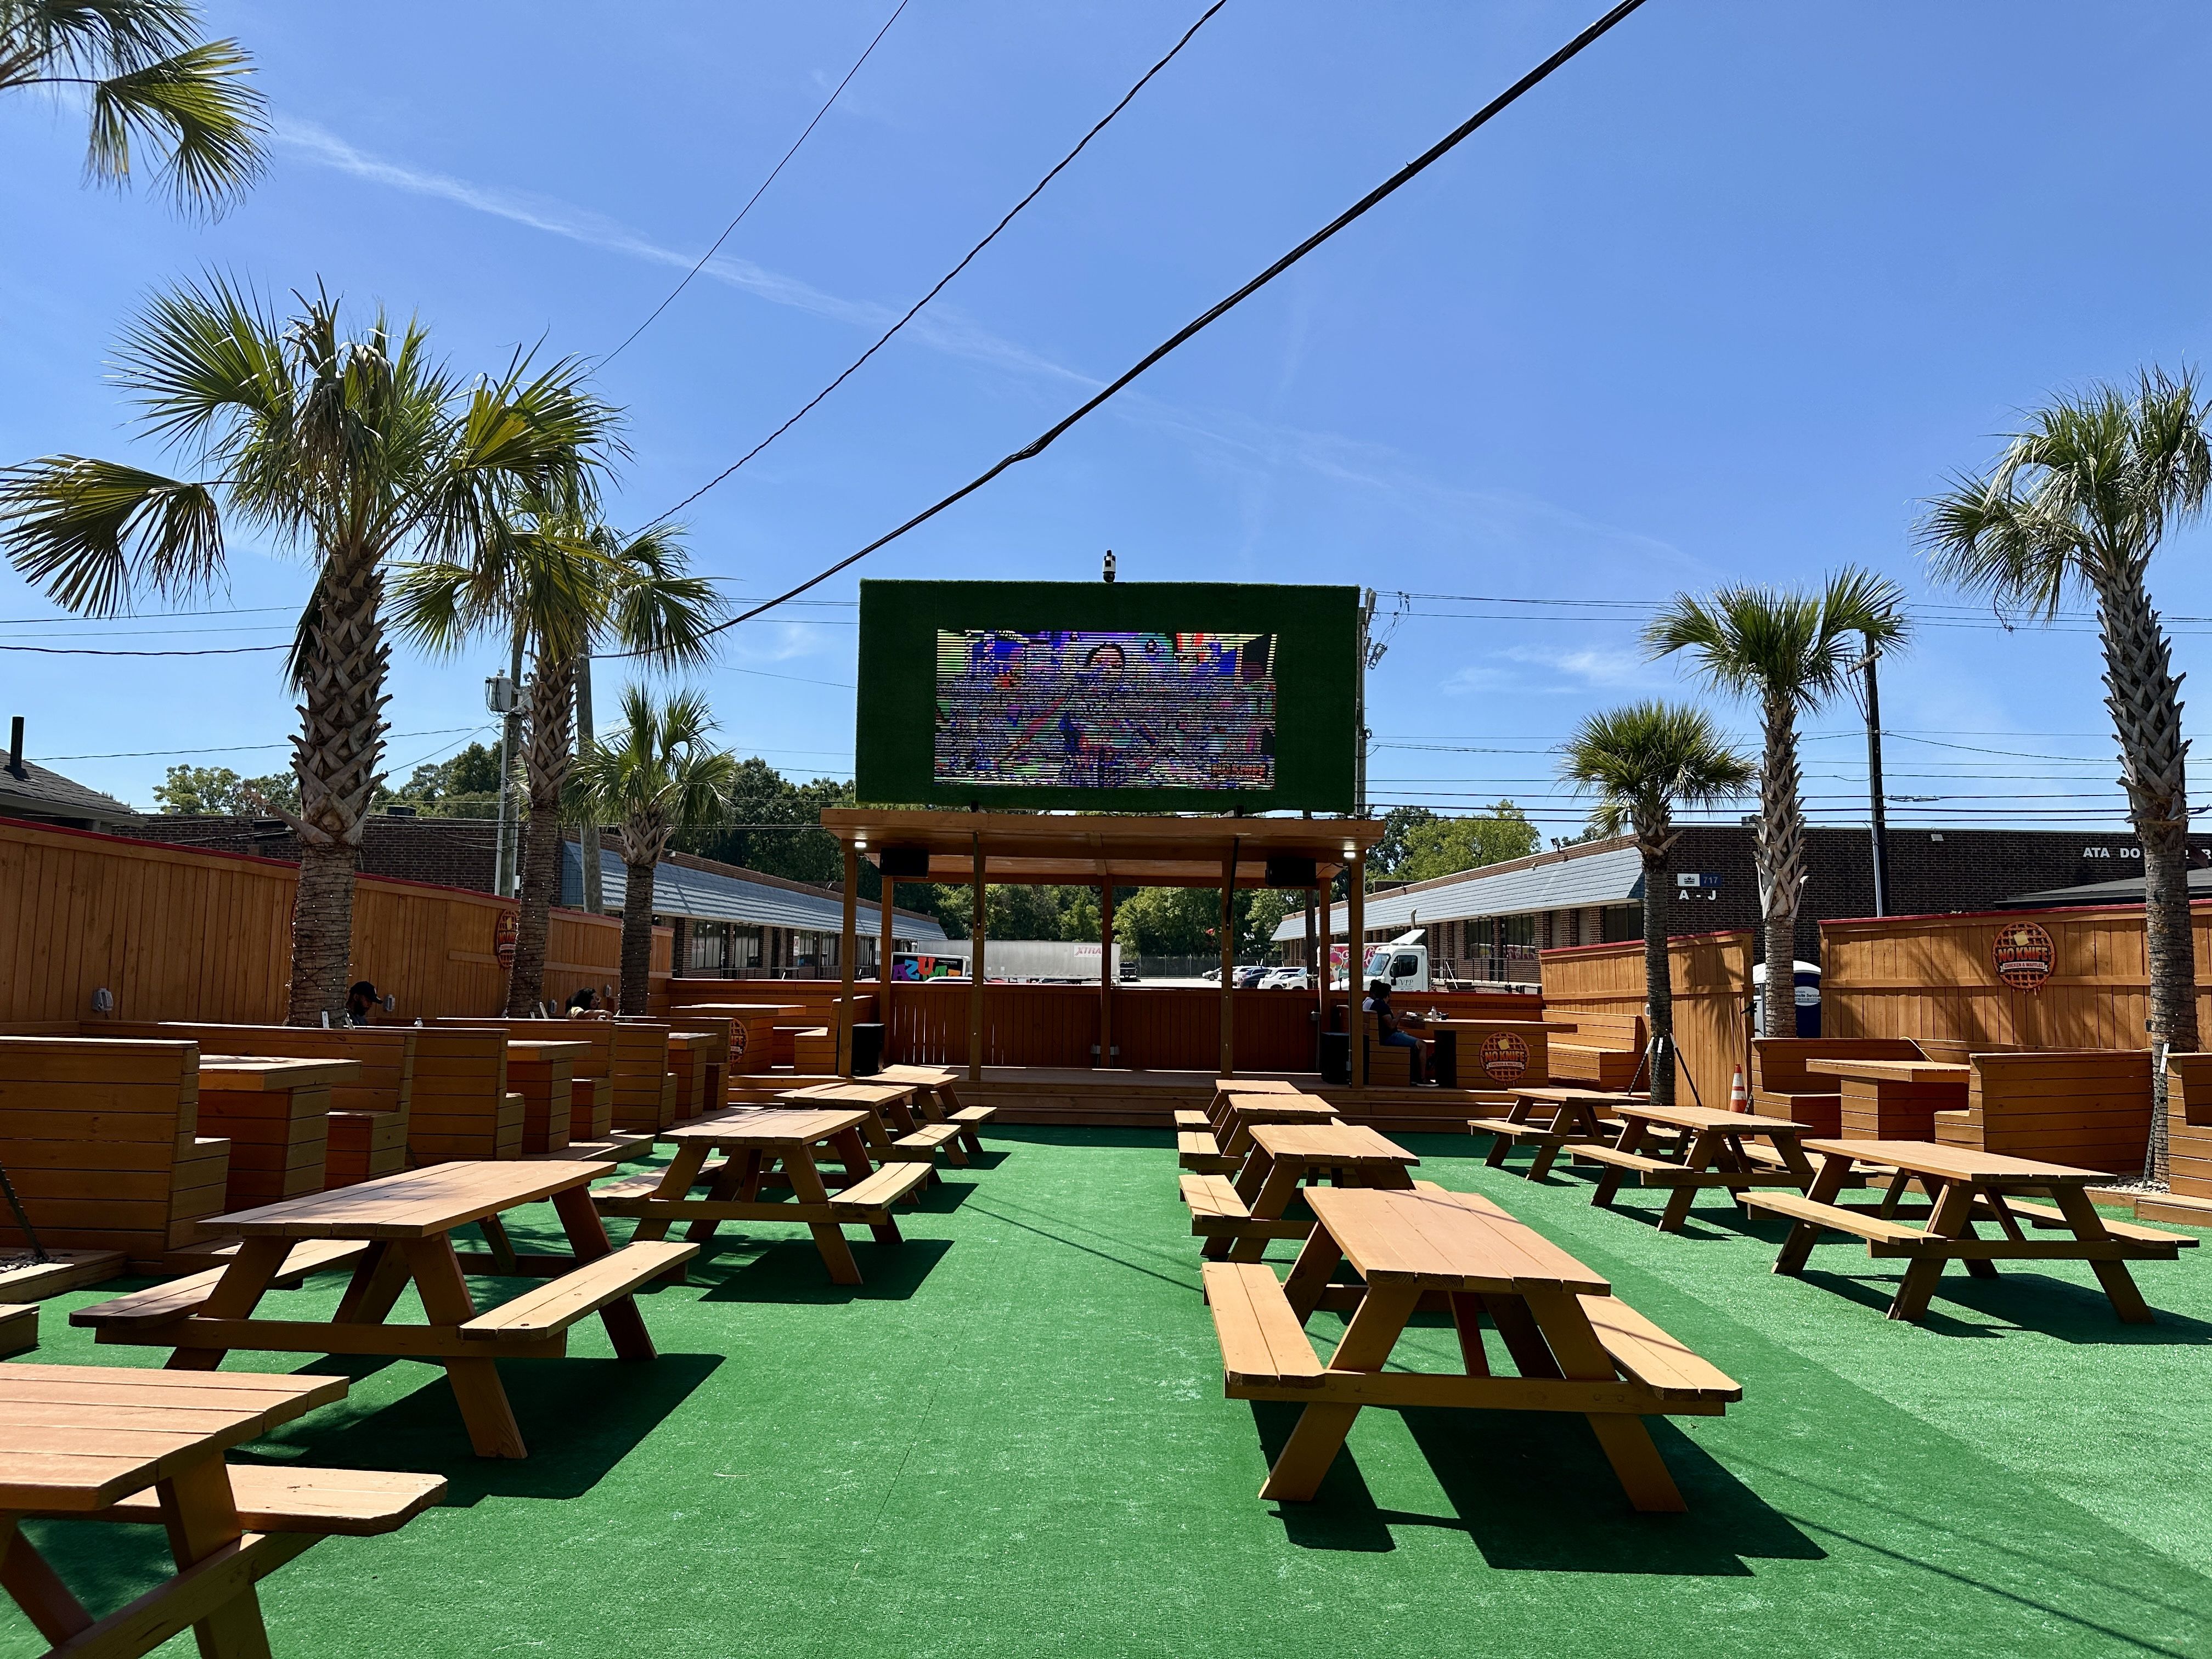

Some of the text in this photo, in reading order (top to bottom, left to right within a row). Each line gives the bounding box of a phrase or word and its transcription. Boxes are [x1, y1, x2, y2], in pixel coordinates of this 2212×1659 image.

[2083, 848, 2110, 857] ATA
[1679, 890, 1690, 900] A
[1708, 890, 1716, 900] J
[1075, 947, 1102, 956] XTRA
[1998, 946, 2049, 963] NO KNIFE
[1485, 1051, 1525, 1062] NO KNIFE
